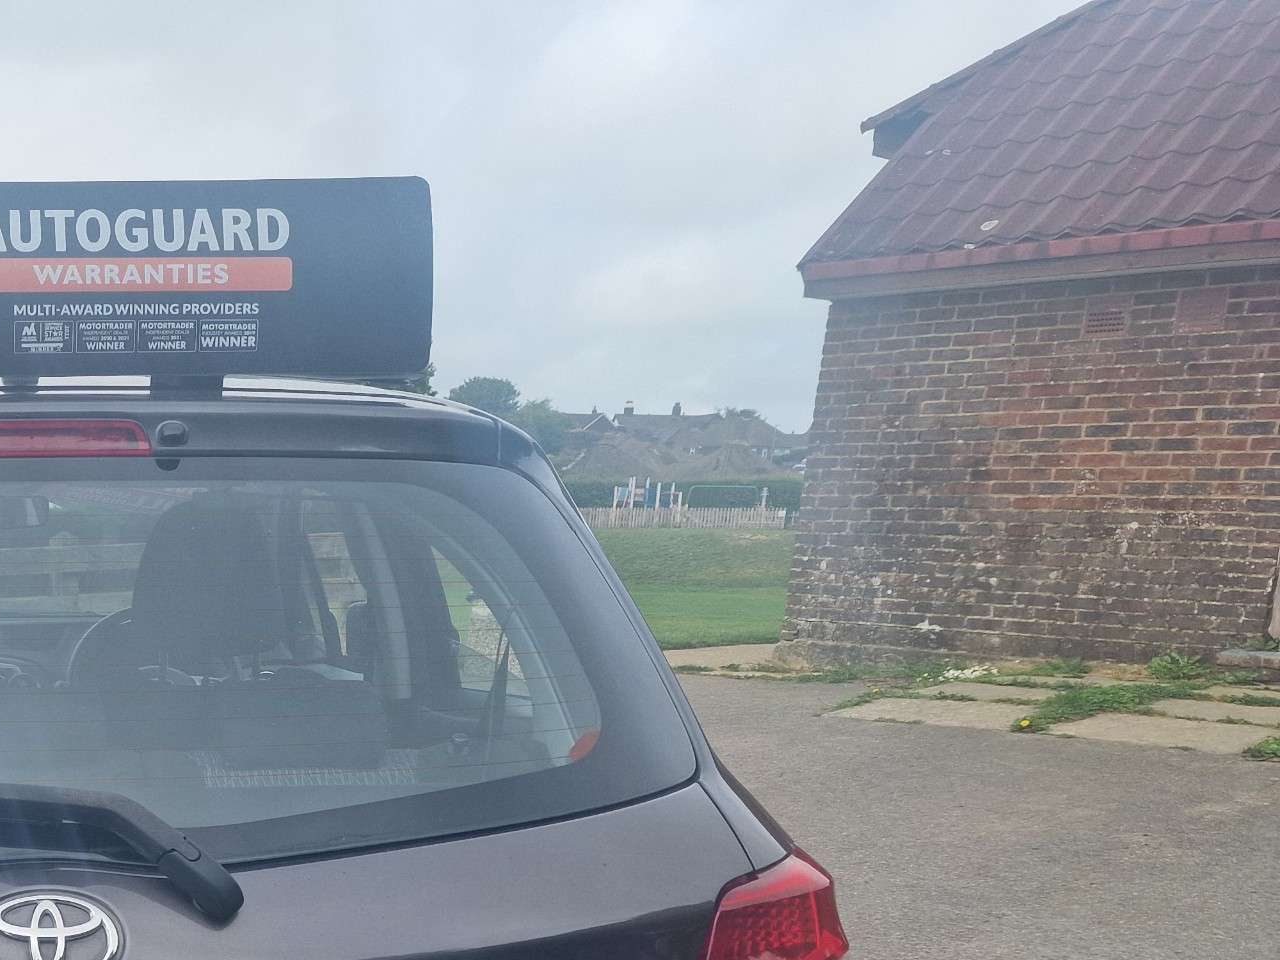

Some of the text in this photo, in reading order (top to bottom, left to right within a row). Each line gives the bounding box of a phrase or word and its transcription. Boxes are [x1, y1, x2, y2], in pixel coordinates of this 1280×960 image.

[32, 263, 229, 286] WARRANTIES
[13, 303, 260, 316] MULTI-AWARD WINNING PROVIDERS
[79, 322, 133, 330] MOTORTRADER
[201, 323, 257, 331] MOTORTRADER
[86, 341, 125, 350] WINNER
[148, 341, 186, 350] WINNER
[200, 336, 257, 348] WINNER
